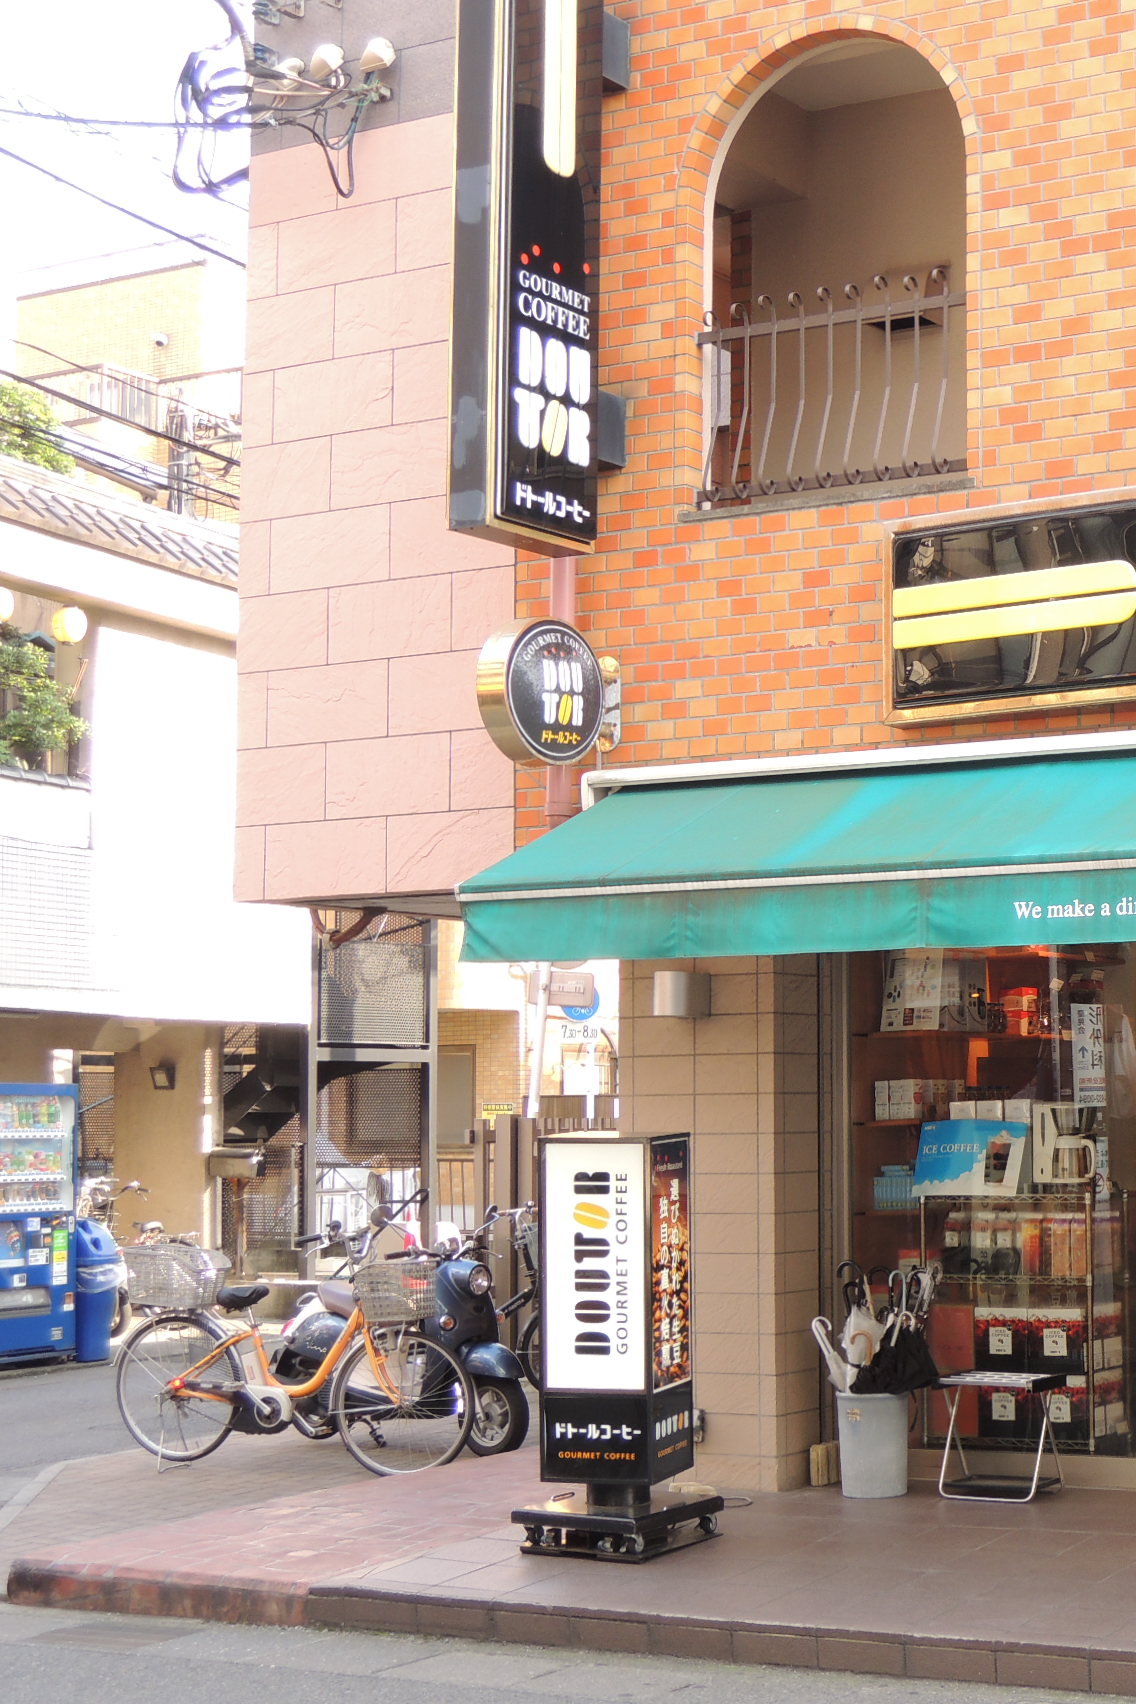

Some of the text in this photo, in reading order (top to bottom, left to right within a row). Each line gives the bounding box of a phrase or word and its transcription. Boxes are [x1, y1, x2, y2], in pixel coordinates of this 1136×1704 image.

[518, 269, 591, 313] GOURMET
[518, 292, 590, 340] COFFEE
[515, 482, 591, 524] ドトールコーヒー
[522, 632, 593, 666] GOURMET COFFEE
[541, 729, 582, 745] ドトールコーヒー
[1013, 901, 1042, 919] We
[1047, 899, 1095, 918] make
[1100, 903, 1111, 916] a
[922, 1143, 980, 1154] ICE COFFEE
[573, 1171, 611, 1355] DOUTOR
[615, 1173, 629, 1355] GOURMET COFFEE
[554, 1422, 642, 1441] ドトールコーヒー
[655, 1410, 689, 1441] DOUTOR
[558, 1450, 636, 1460] GOURMET COFFEE
